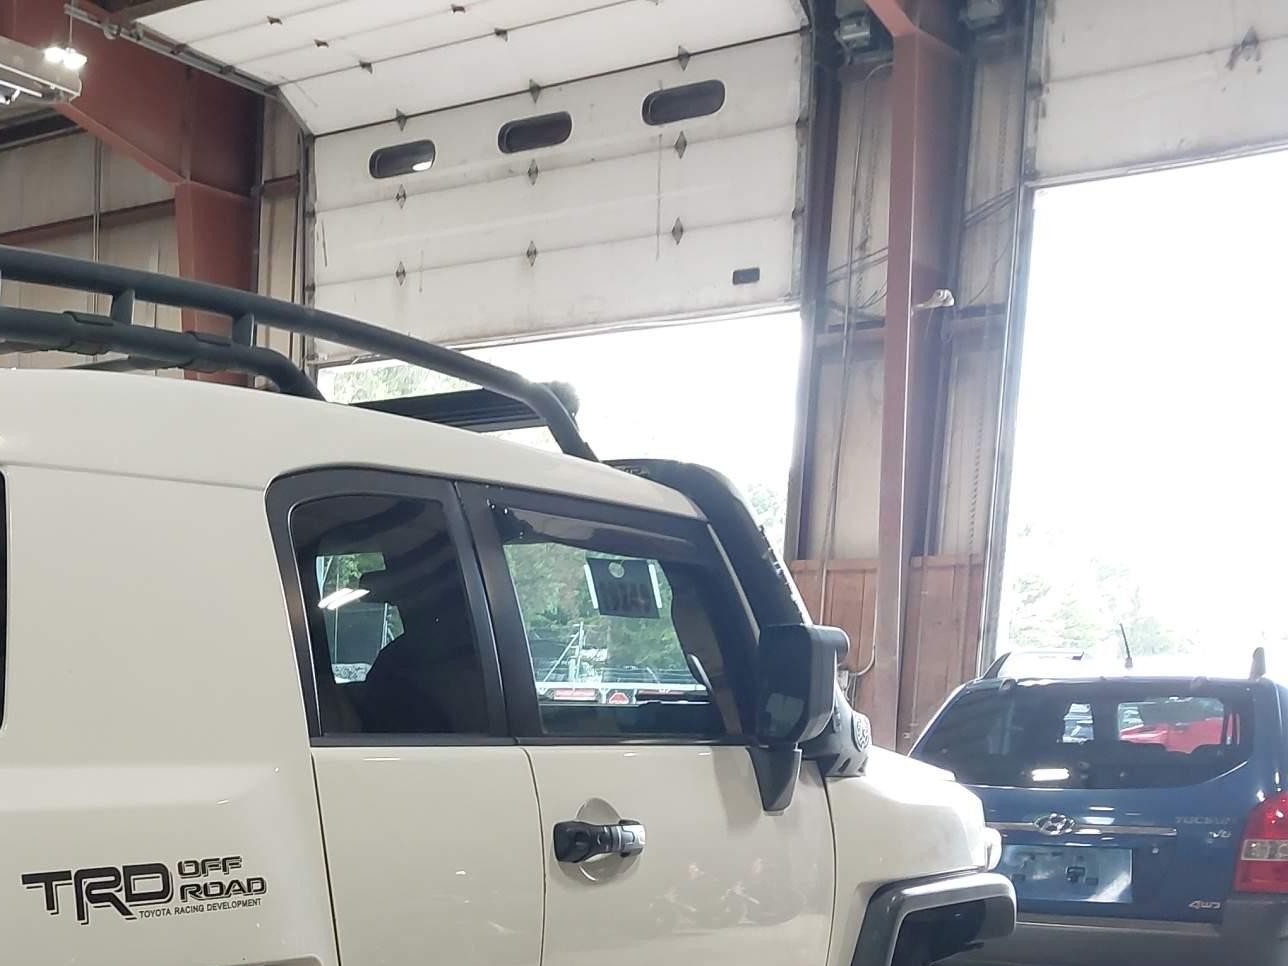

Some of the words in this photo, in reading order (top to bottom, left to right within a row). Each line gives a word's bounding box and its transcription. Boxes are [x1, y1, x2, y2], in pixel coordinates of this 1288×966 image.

[178, 855, 242, 879] OFF
[21, 862, 173, 925] TRD
[179, 877, 267, 903] ROAD
[139, 908, 172, 918] TOYOTA
[174, 904, 204, 915] RACING
[206, 898, 262, 912] DEVELOPMENT
[1189, 900, 1221, 909] 4WD
